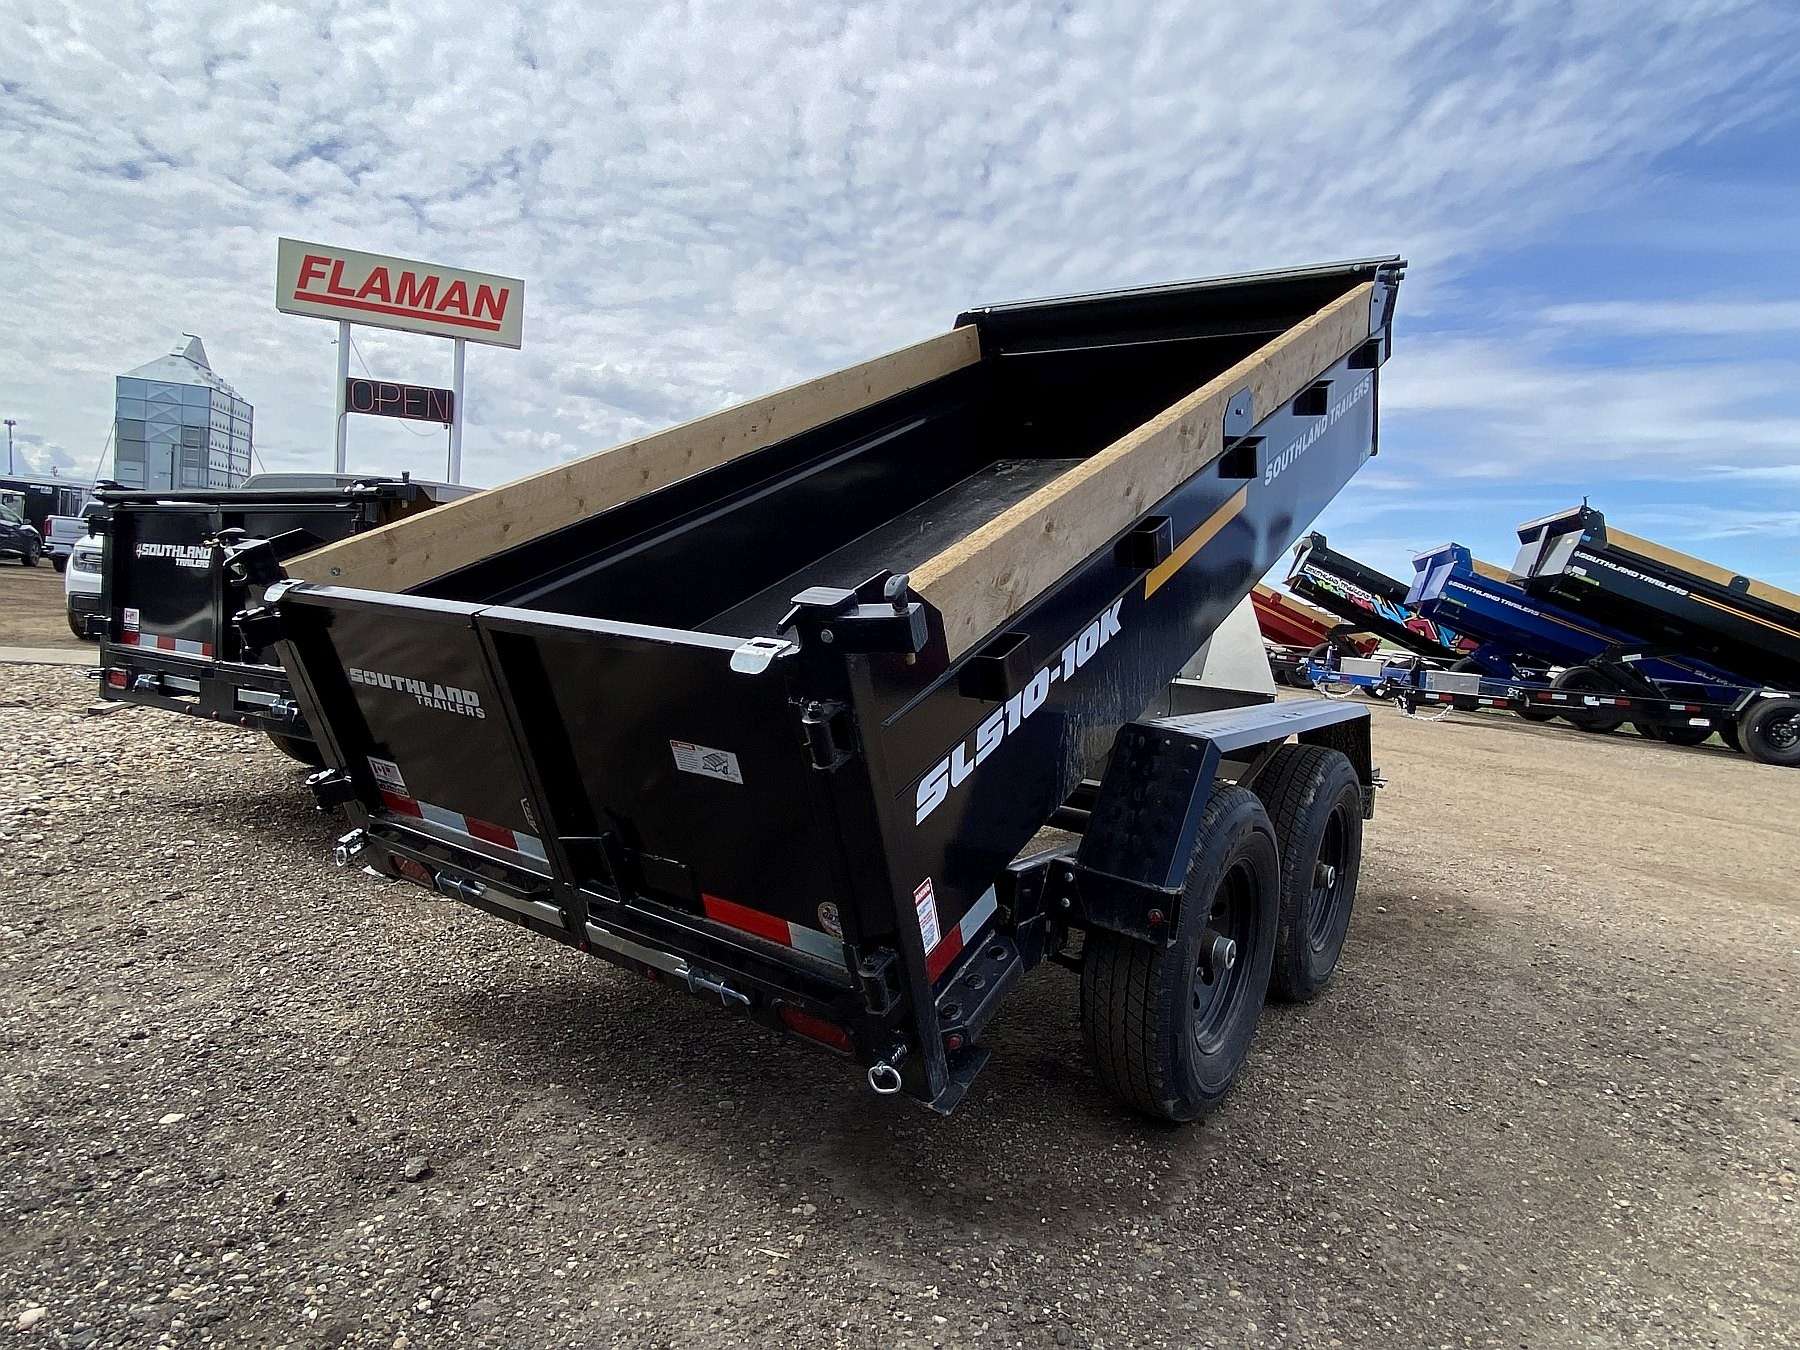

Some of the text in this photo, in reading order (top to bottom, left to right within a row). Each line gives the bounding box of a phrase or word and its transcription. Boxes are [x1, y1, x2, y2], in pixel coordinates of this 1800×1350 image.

[296, 254, 510, 321] FLAMAN
[351, 379, 449, 420] OPEN
[1264, 377, 1370, 486] SOUTHLAND TRAILERS
[141, 543, 212, 559] SOUTHLAND
[176, 558, 210, 568] TRAILERS
[1579, 551, 1689, 596] SOUTHLAND TRAILERS
[1453, 581, 1540, 616] SOUTHLAND TRAILERS
[349, 667, 481, 707] SOUTHLAND
[414, 694, 486, 719] TRAILERS
